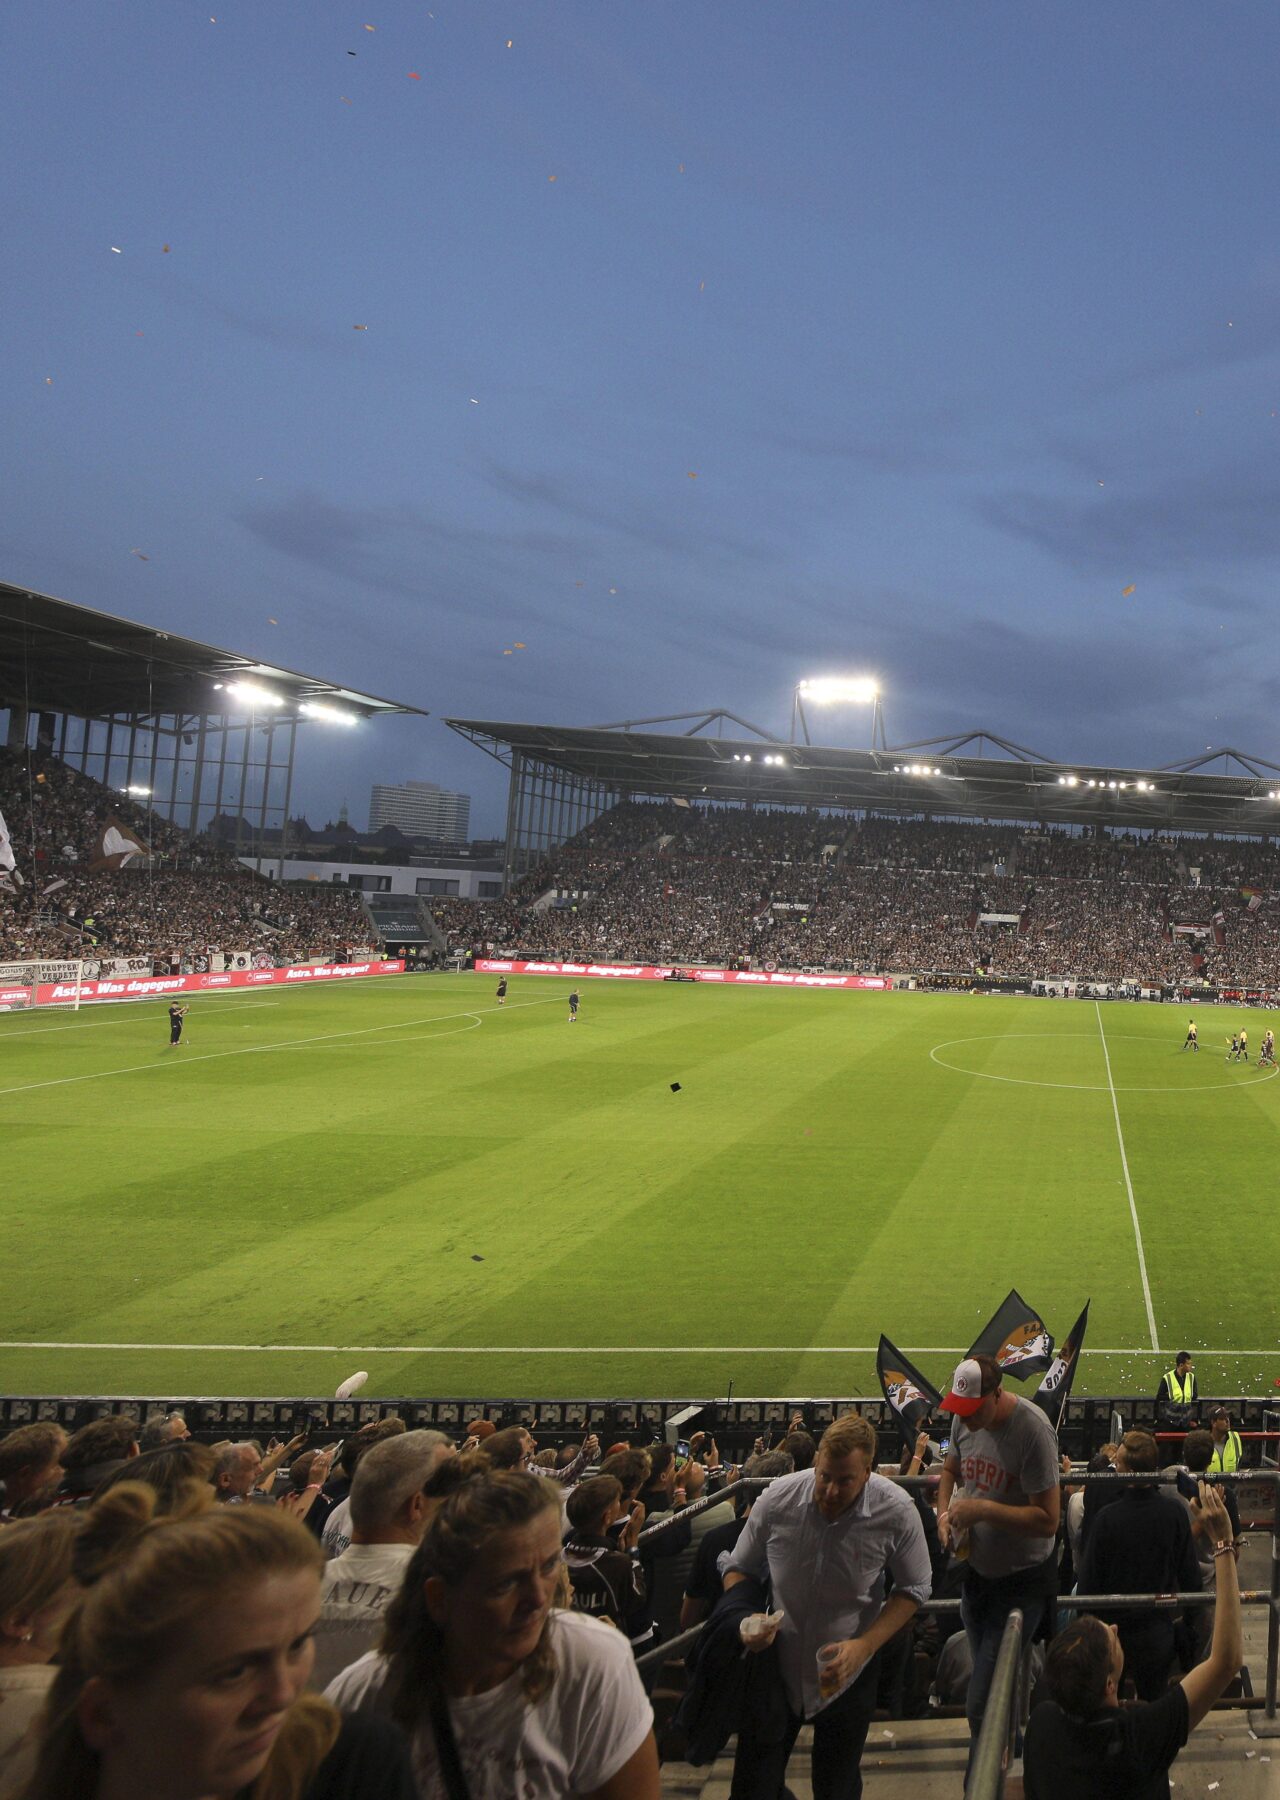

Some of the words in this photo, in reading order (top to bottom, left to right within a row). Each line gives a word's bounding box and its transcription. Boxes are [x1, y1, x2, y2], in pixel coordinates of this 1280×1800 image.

[286, 969, 312, 979] Astra.
[314, 967, 331, 976] Was
[332, 964, 370, 976] dagegen?
[52, 985, 94, 998] Astra.
[97, 981, 125, 993] Was
[127, 978, 186, 993] dagegen?
